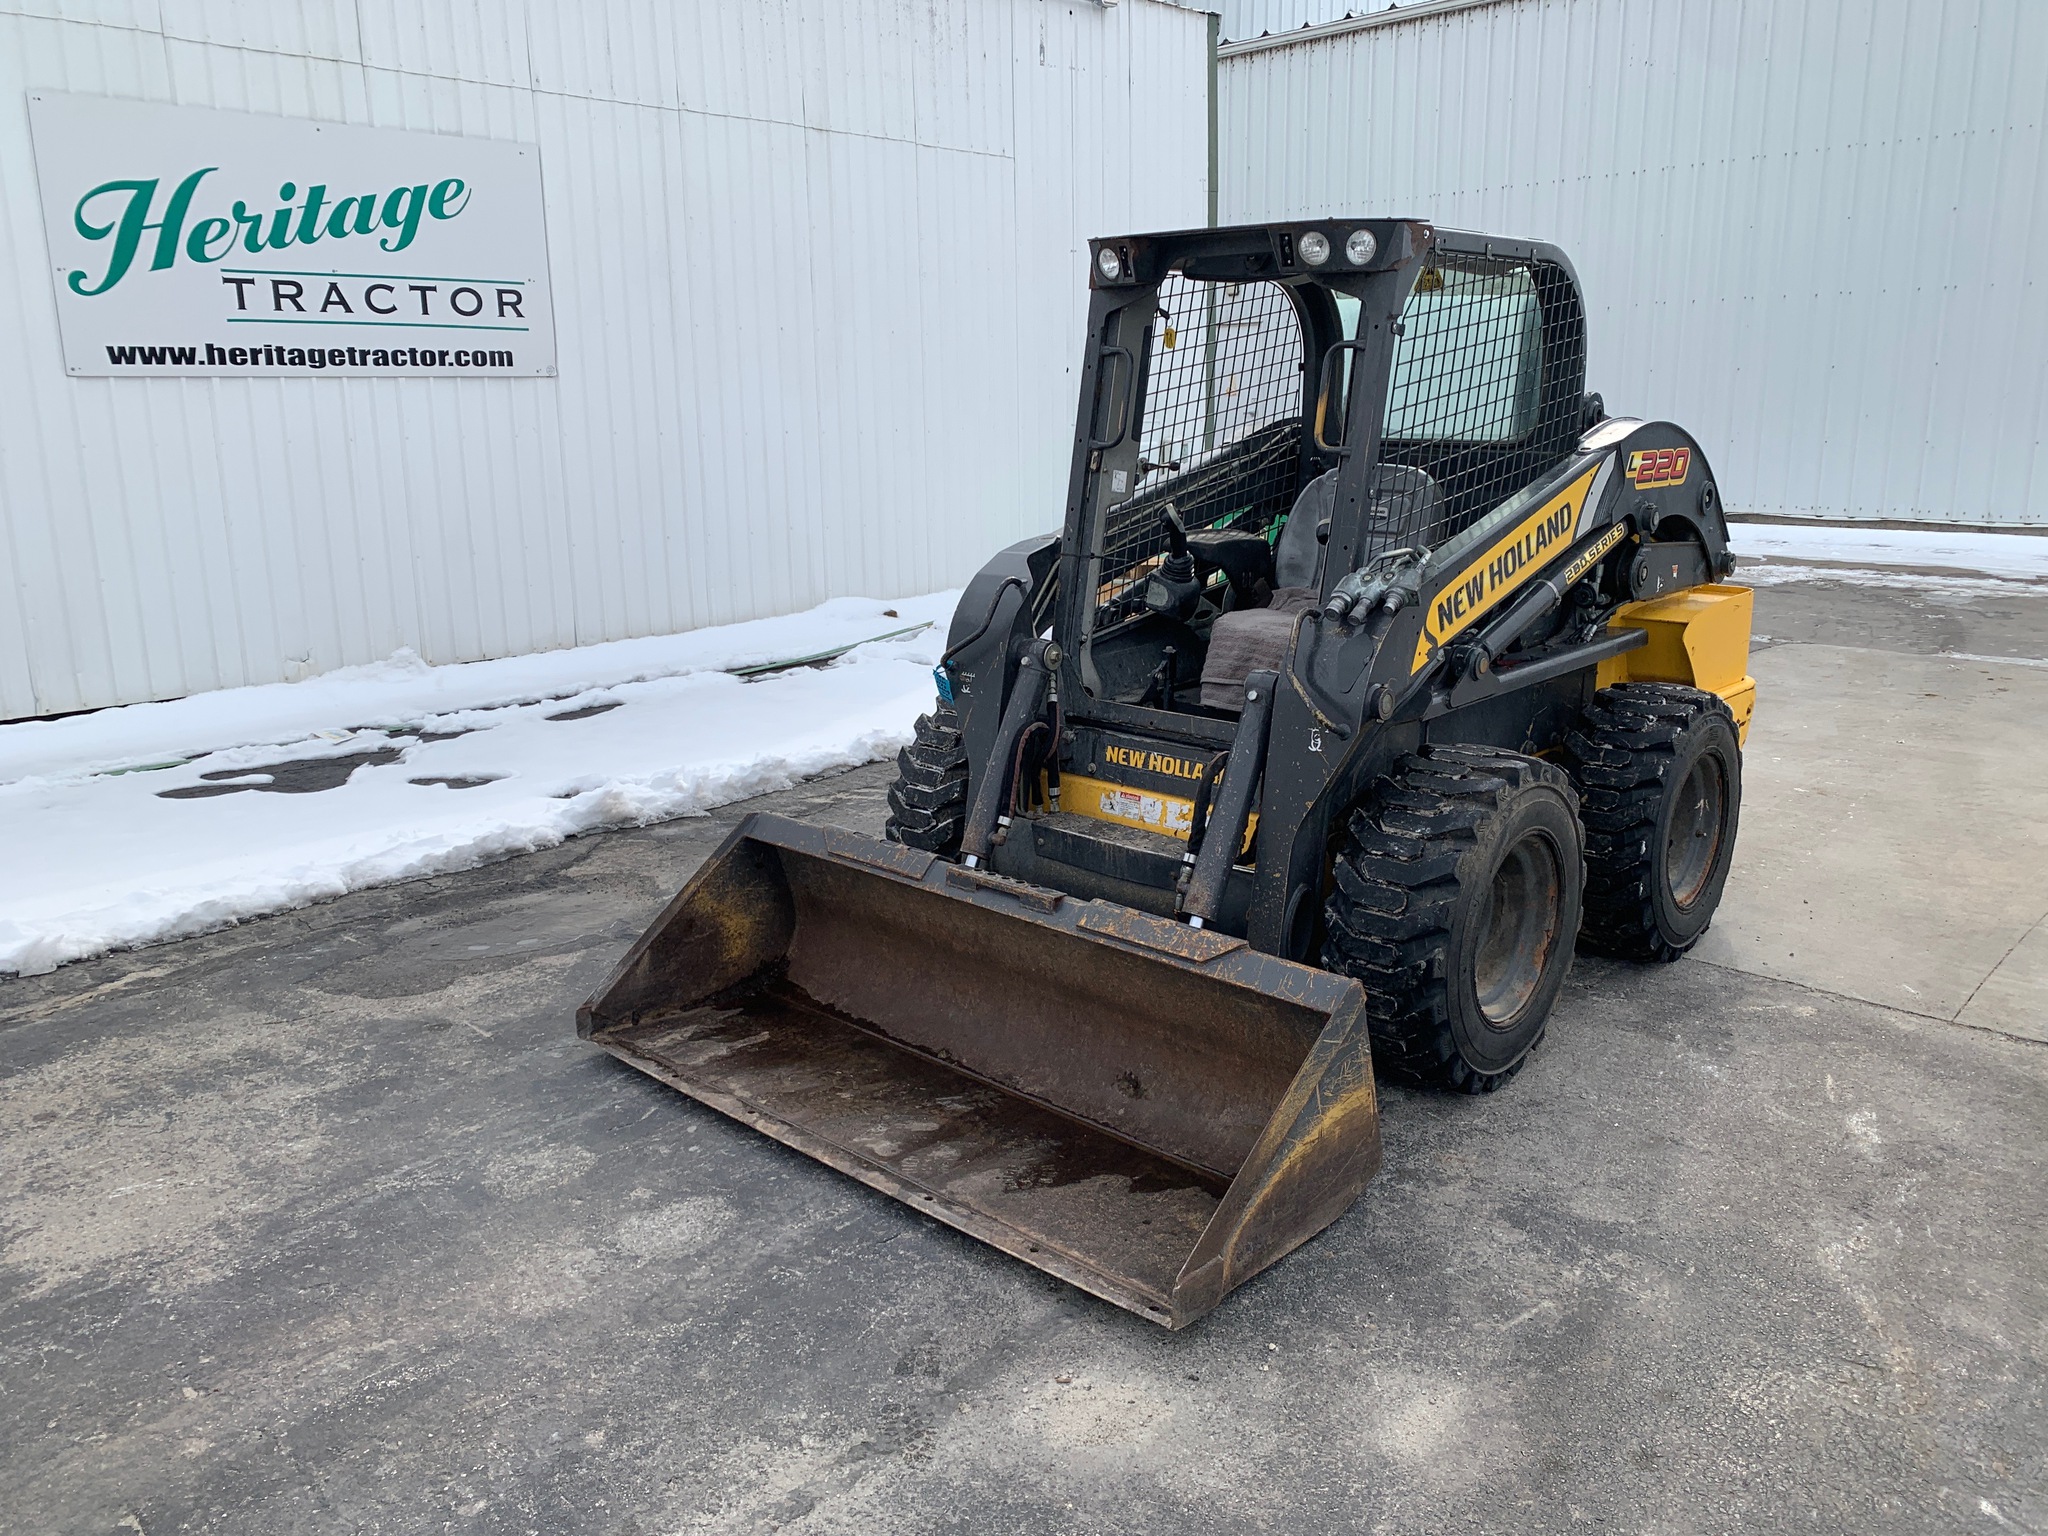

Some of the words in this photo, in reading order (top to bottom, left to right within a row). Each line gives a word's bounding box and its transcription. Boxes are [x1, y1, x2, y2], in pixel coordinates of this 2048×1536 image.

[68, 167, 471, 296] Heritage
[222, 276, 526, 319] TRACTOR
[106, 342, 514, 369] www.heritagetractor.com
[1627, 448, 1690, 487] L220
[1588, 523, 1624, 561] SERIES
[1437, 569, 1484, 633] NEW
[1489, 501, 1572, 593] HOLLAND
[1106, 745, 1146, 769] NEW
[1148, 752, 1225, 785] HOLLA
